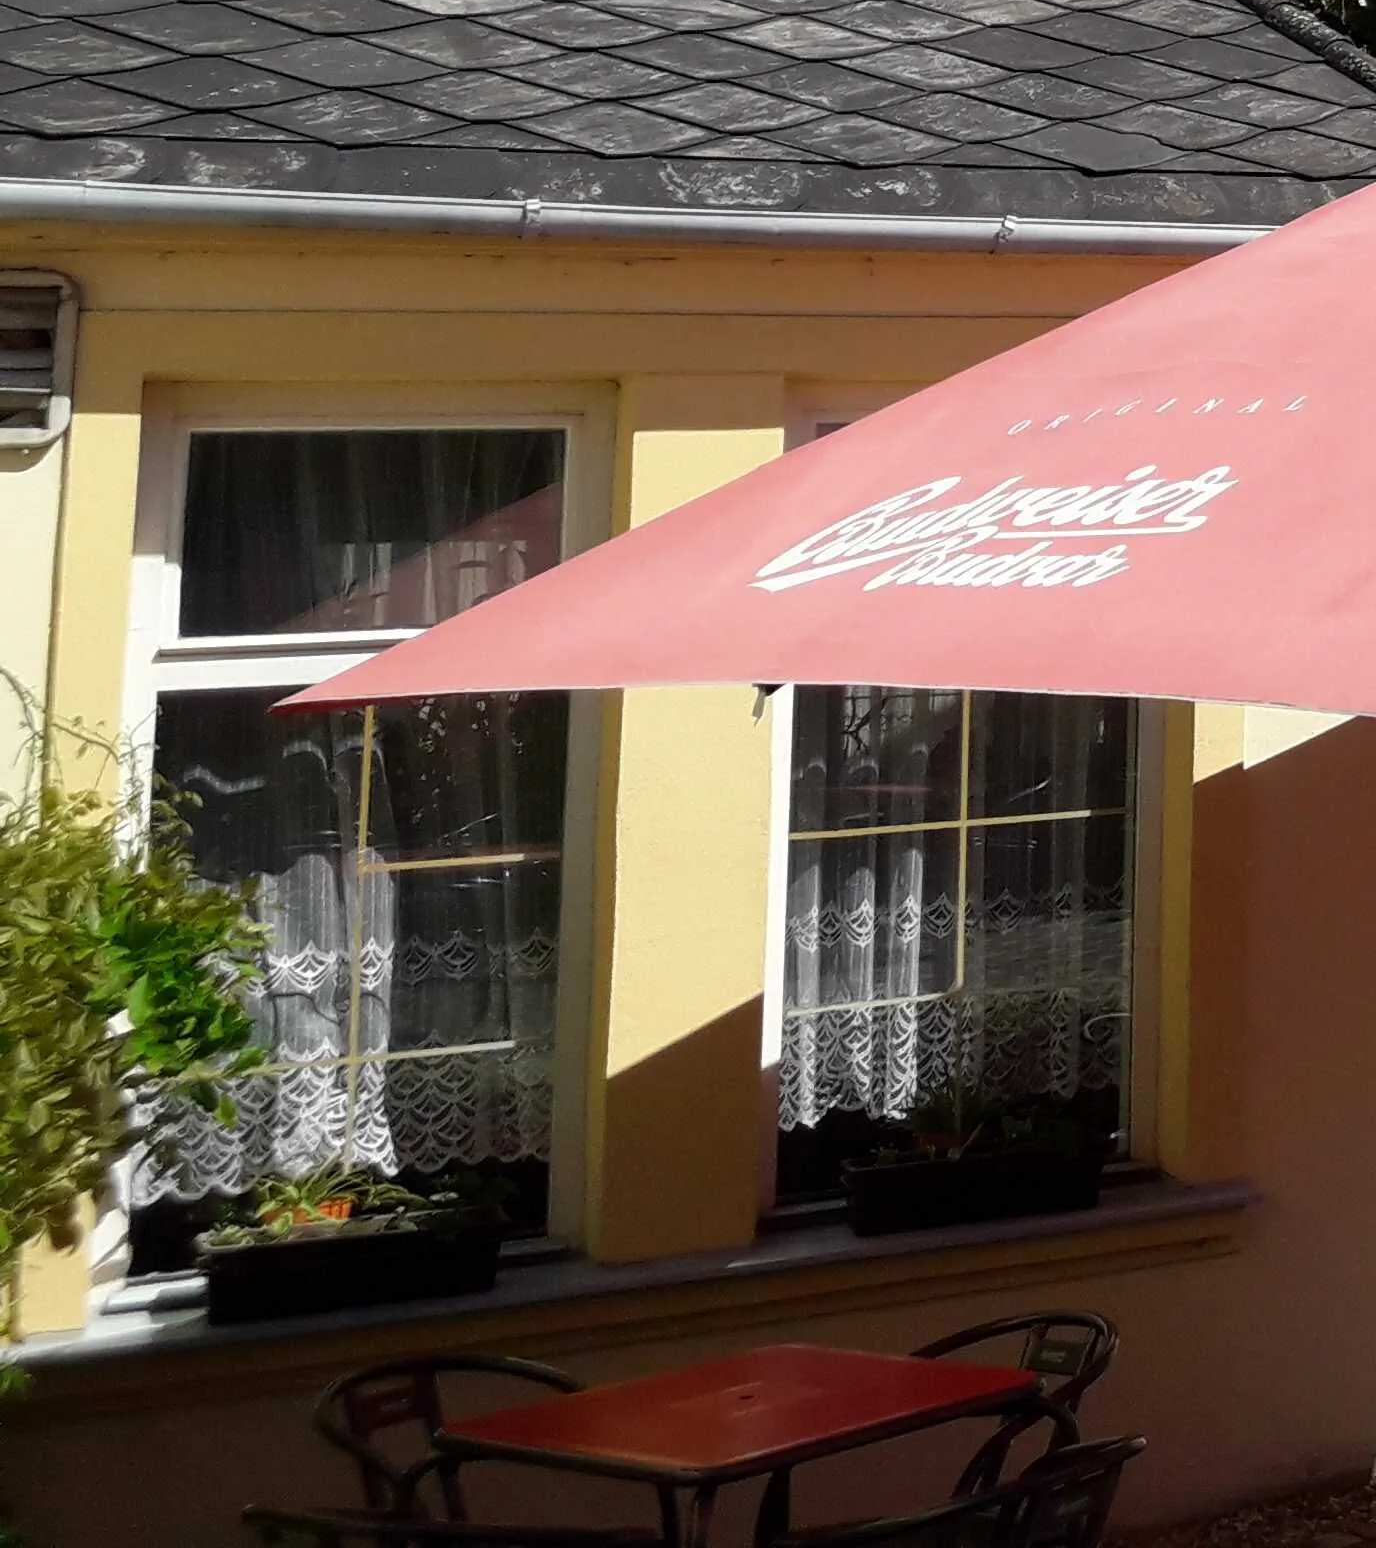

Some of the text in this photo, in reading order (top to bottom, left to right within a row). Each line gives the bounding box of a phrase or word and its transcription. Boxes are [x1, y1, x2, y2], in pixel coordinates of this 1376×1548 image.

[1007, 395, 1309, 436] ORIGINAL
[747, 464, 1240, 592] Budweiser
[862, 526, 1132, 592] Budvar
